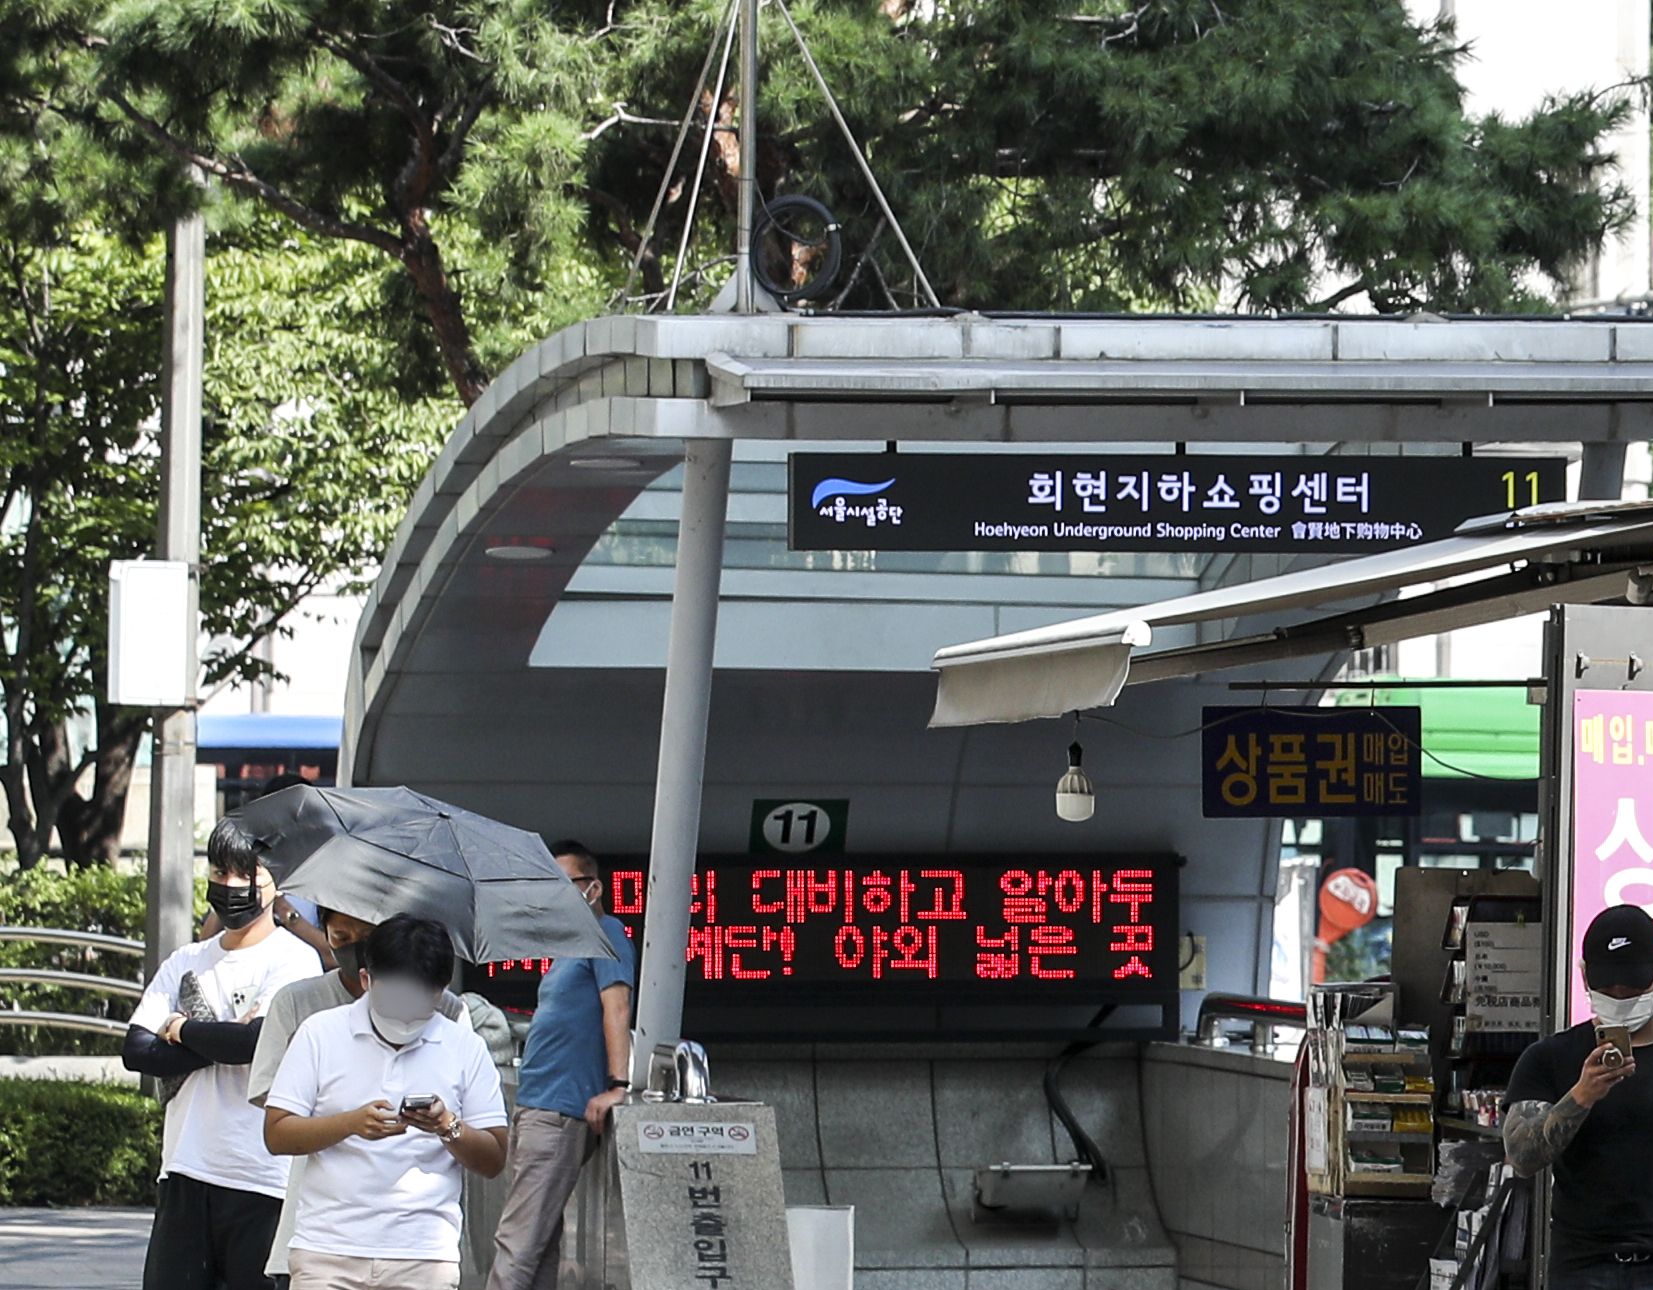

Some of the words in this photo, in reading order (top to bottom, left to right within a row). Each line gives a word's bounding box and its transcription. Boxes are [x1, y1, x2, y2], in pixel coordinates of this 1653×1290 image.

[1028, 470, 1370, 514] 회현지하쇼핑센터
[1502, 471, 1539, 509] 11
[819, 497, 903, 527] 서울시설공단
[974, 521, 1049, 540] Hoehyeon
[1053, 521, 1152, 540] Underground
[1156, 522, 1225, 541] Shopping
[1230, 522, 1282, 538] Center
[1363, 732, 1409, 766] 매입
[1215, 732, 1357, 806] 상품권
[1363, 772, 1409, 805] 매도
[773, 809, 818, 845] 11
[752, 870, 967, 923] 대비하고
[1000, 870, 1153, 923] 알아두
[834, 925, 937, 979] 야외
[976, 925, 1077, 979] 넓은
[1109, 925, 1153, 979] 곳
[669, 1126, 694, 1137] 금연
[698, 1126, 724, 1137] 구역
